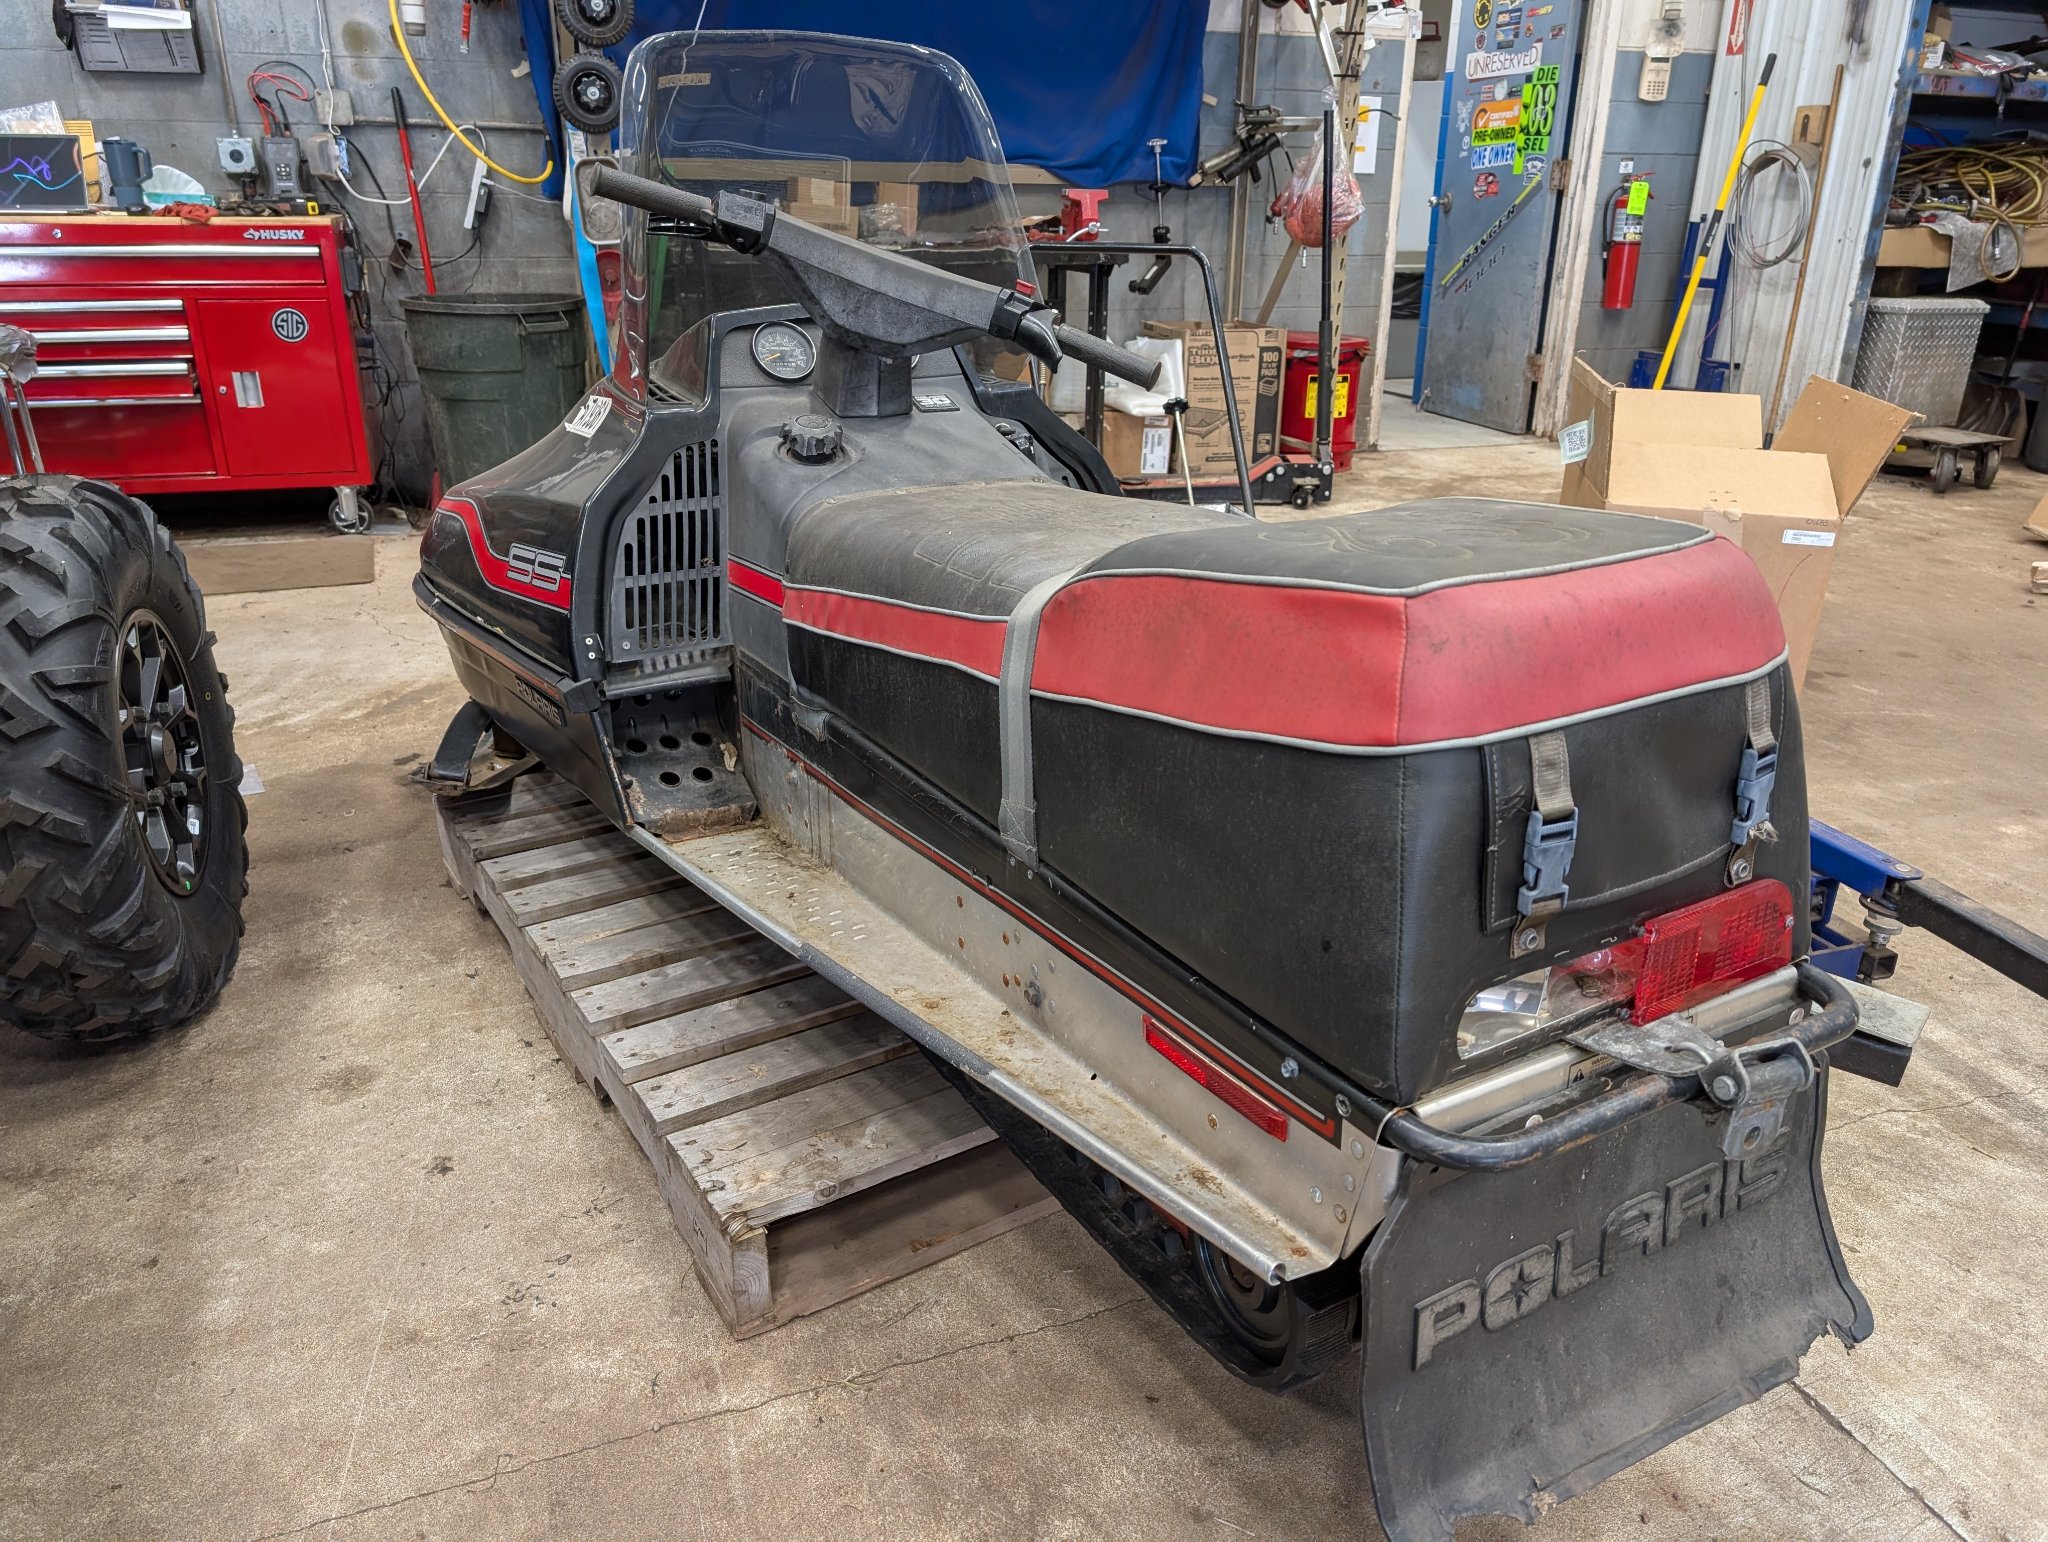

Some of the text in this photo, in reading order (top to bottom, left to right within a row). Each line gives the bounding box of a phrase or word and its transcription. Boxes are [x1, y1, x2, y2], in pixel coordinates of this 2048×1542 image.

[1468, 46, 1538, 77] UNRESERVED
[1537, 66, 1558, 81] DIE
[1474, 127, 1516, 143] PRE-OWNED
[1523, 136, 1545, 152] SEL
[1472, 142, 1516, 168] ONE OWNER
[260, 229, 305, 240] HUSKY
[1461, 203, 1517, 271] RANGER
[276, 312, 304, 338] SIG
[1262, 351, 1279, 362] 100
[1261, 368, 1278, 376] PADS
[507, 542, 566, 592] SS
[515, 678, 562, 726] POLARIS
[1411, 1126, 1790, 1371] POLARIS
